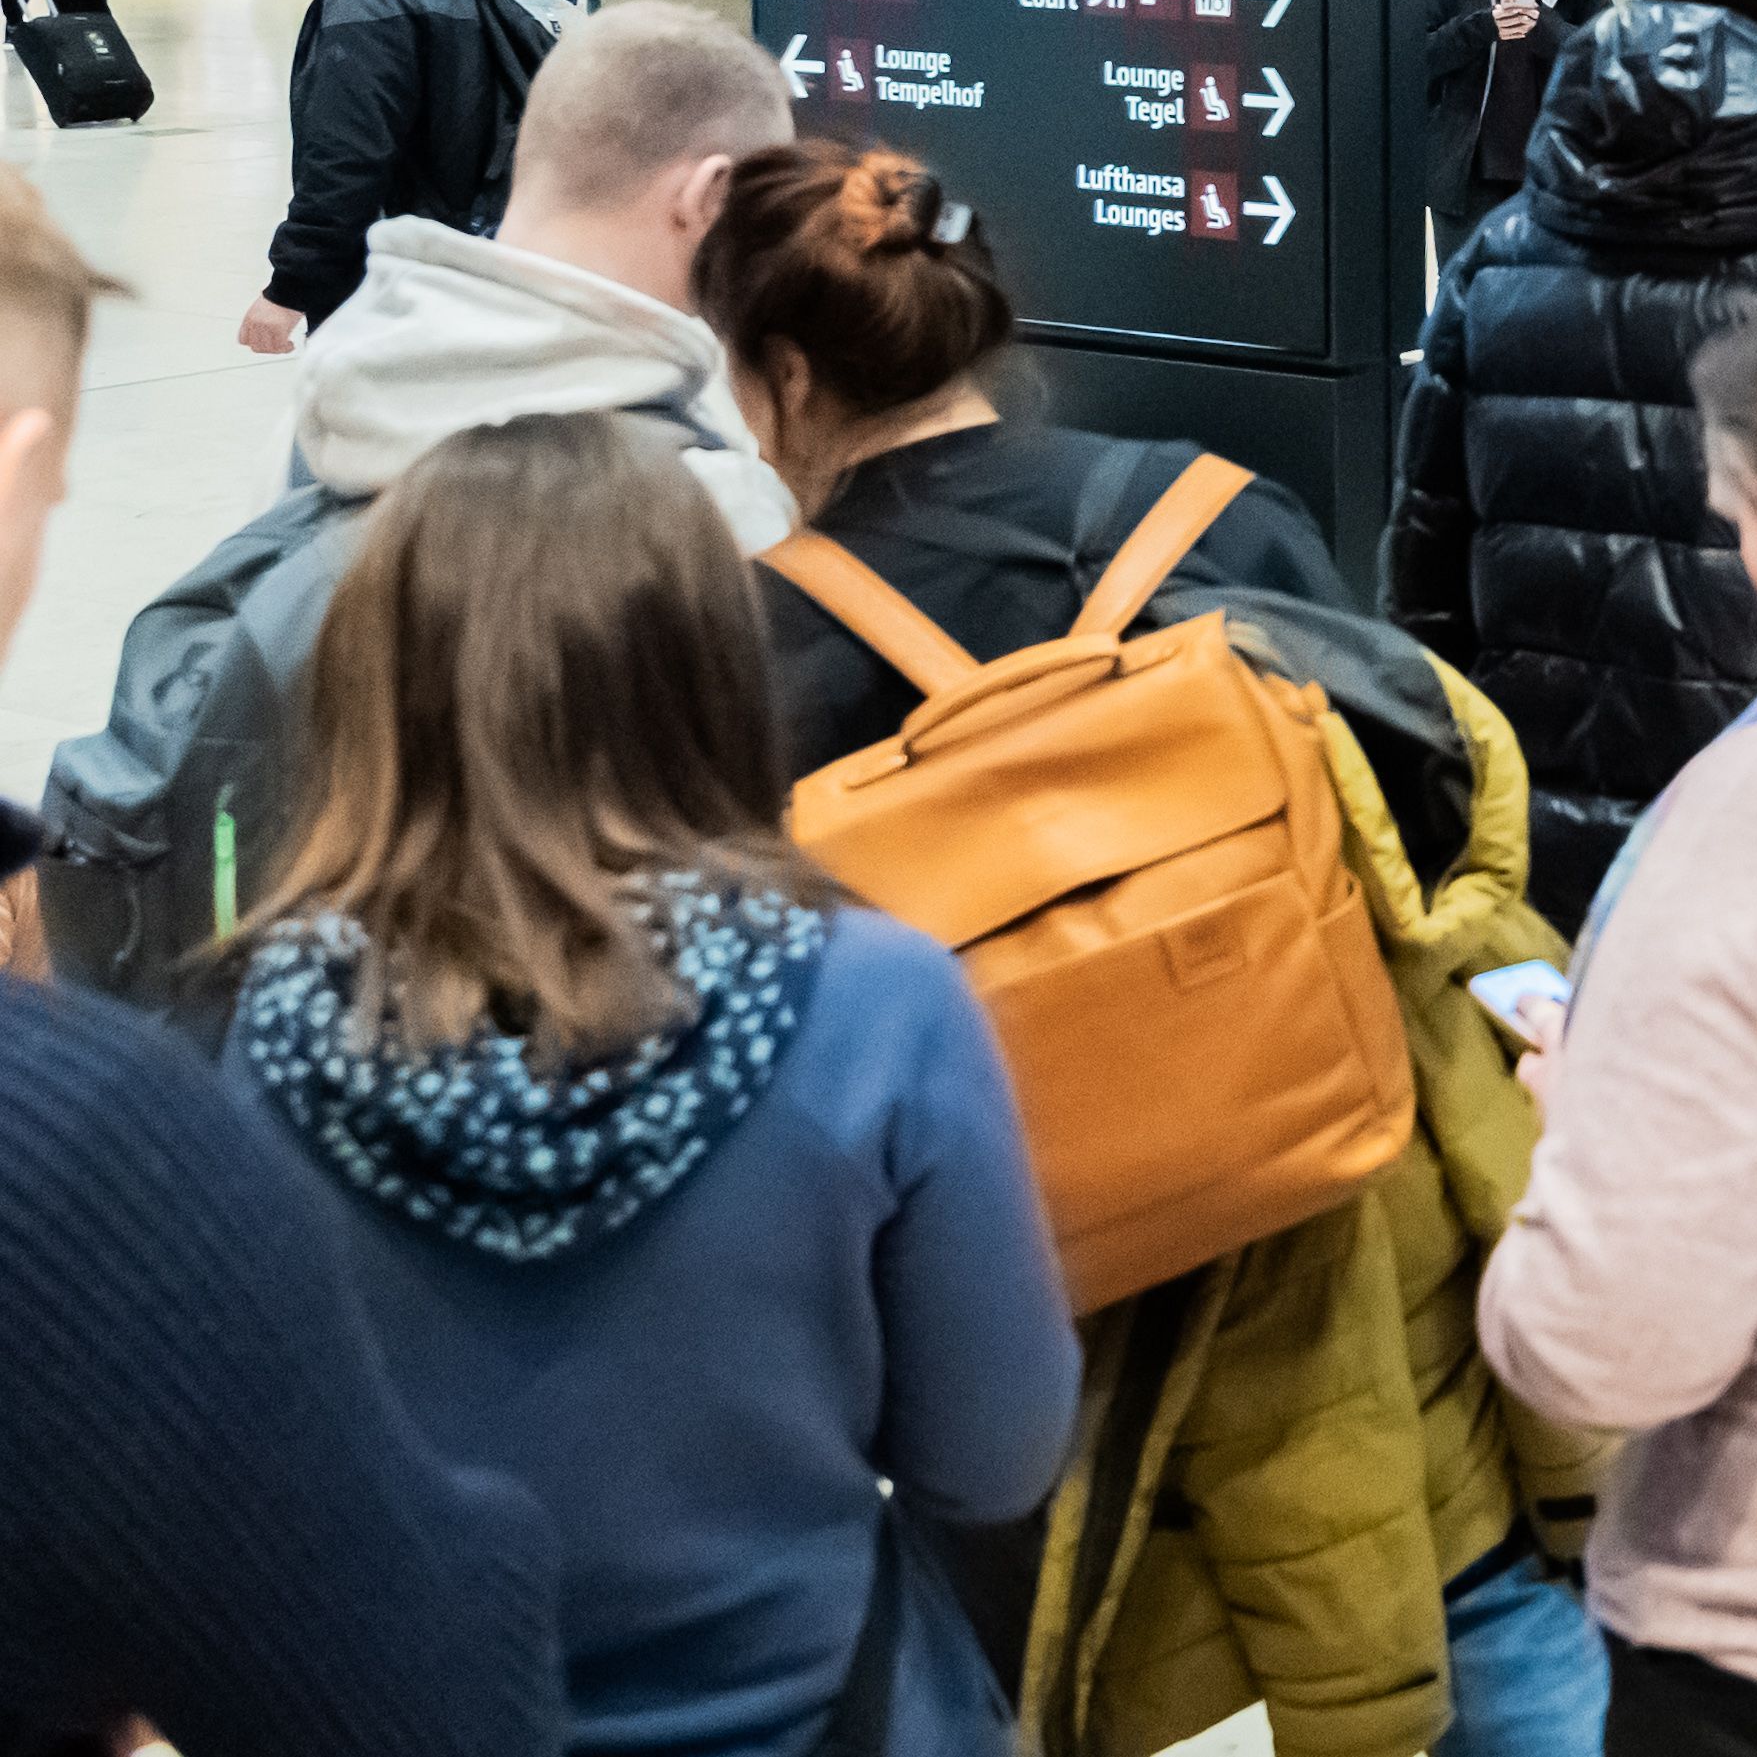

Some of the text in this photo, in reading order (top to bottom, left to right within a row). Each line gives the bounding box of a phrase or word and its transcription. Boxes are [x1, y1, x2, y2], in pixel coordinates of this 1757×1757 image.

[875, 44, 951, 77] Lounge
[1103, 60, 1185, 96] Lounge
[875, 76, 985, 110] Tempelhof
[1125, 95, 1186, 130] Tegel
[1075, 163, 1186, 198] Lufthansa
[1093, 198, 1187, 236] Lounges
